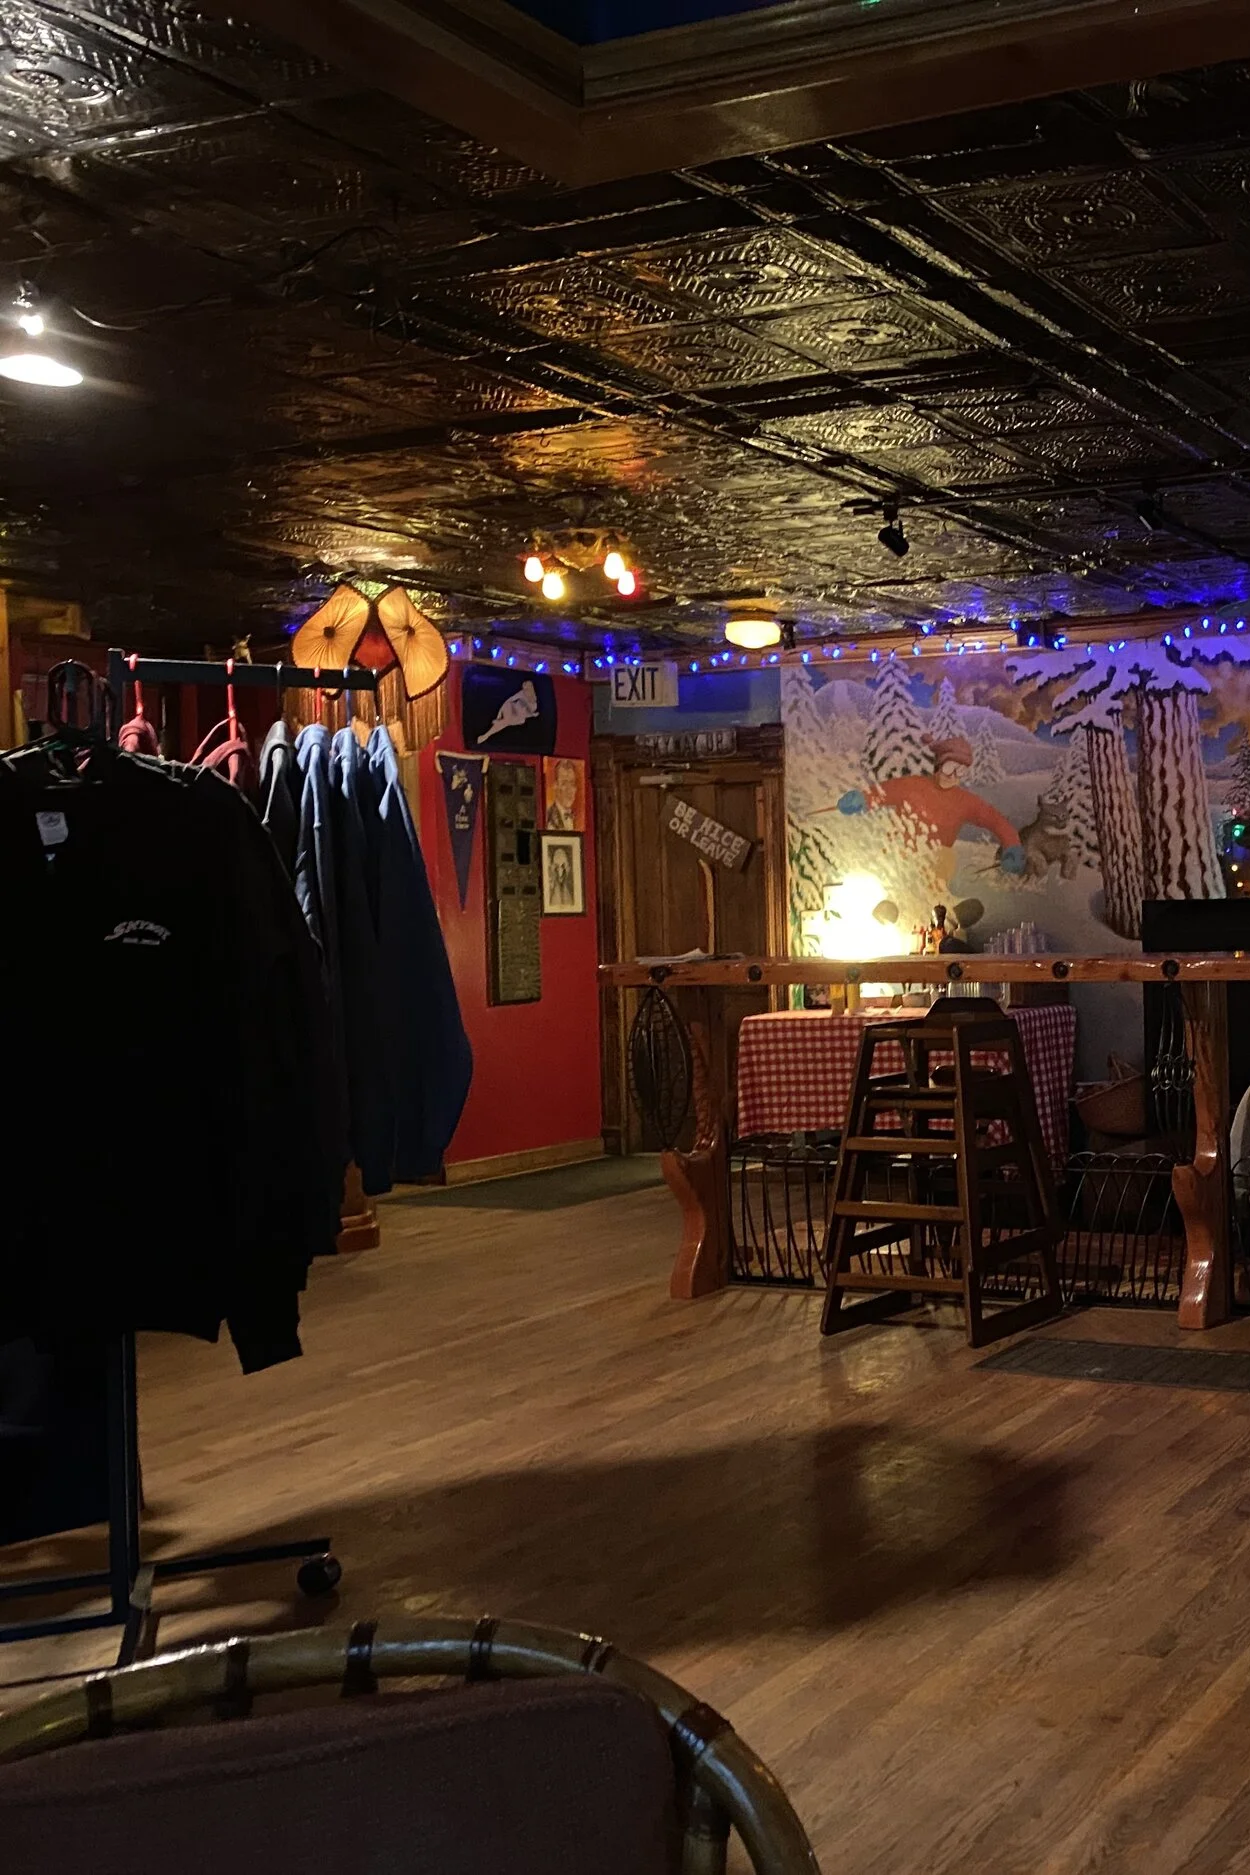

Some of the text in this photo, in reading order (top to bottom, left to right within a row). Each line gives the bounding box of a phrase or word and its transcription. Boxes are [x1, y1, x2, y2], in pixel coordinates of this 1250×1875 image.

[615, 668, 658, 701] EXIT
[669, 817, 689, 838] OR
[675, 801, 745, 854] BE NICE
